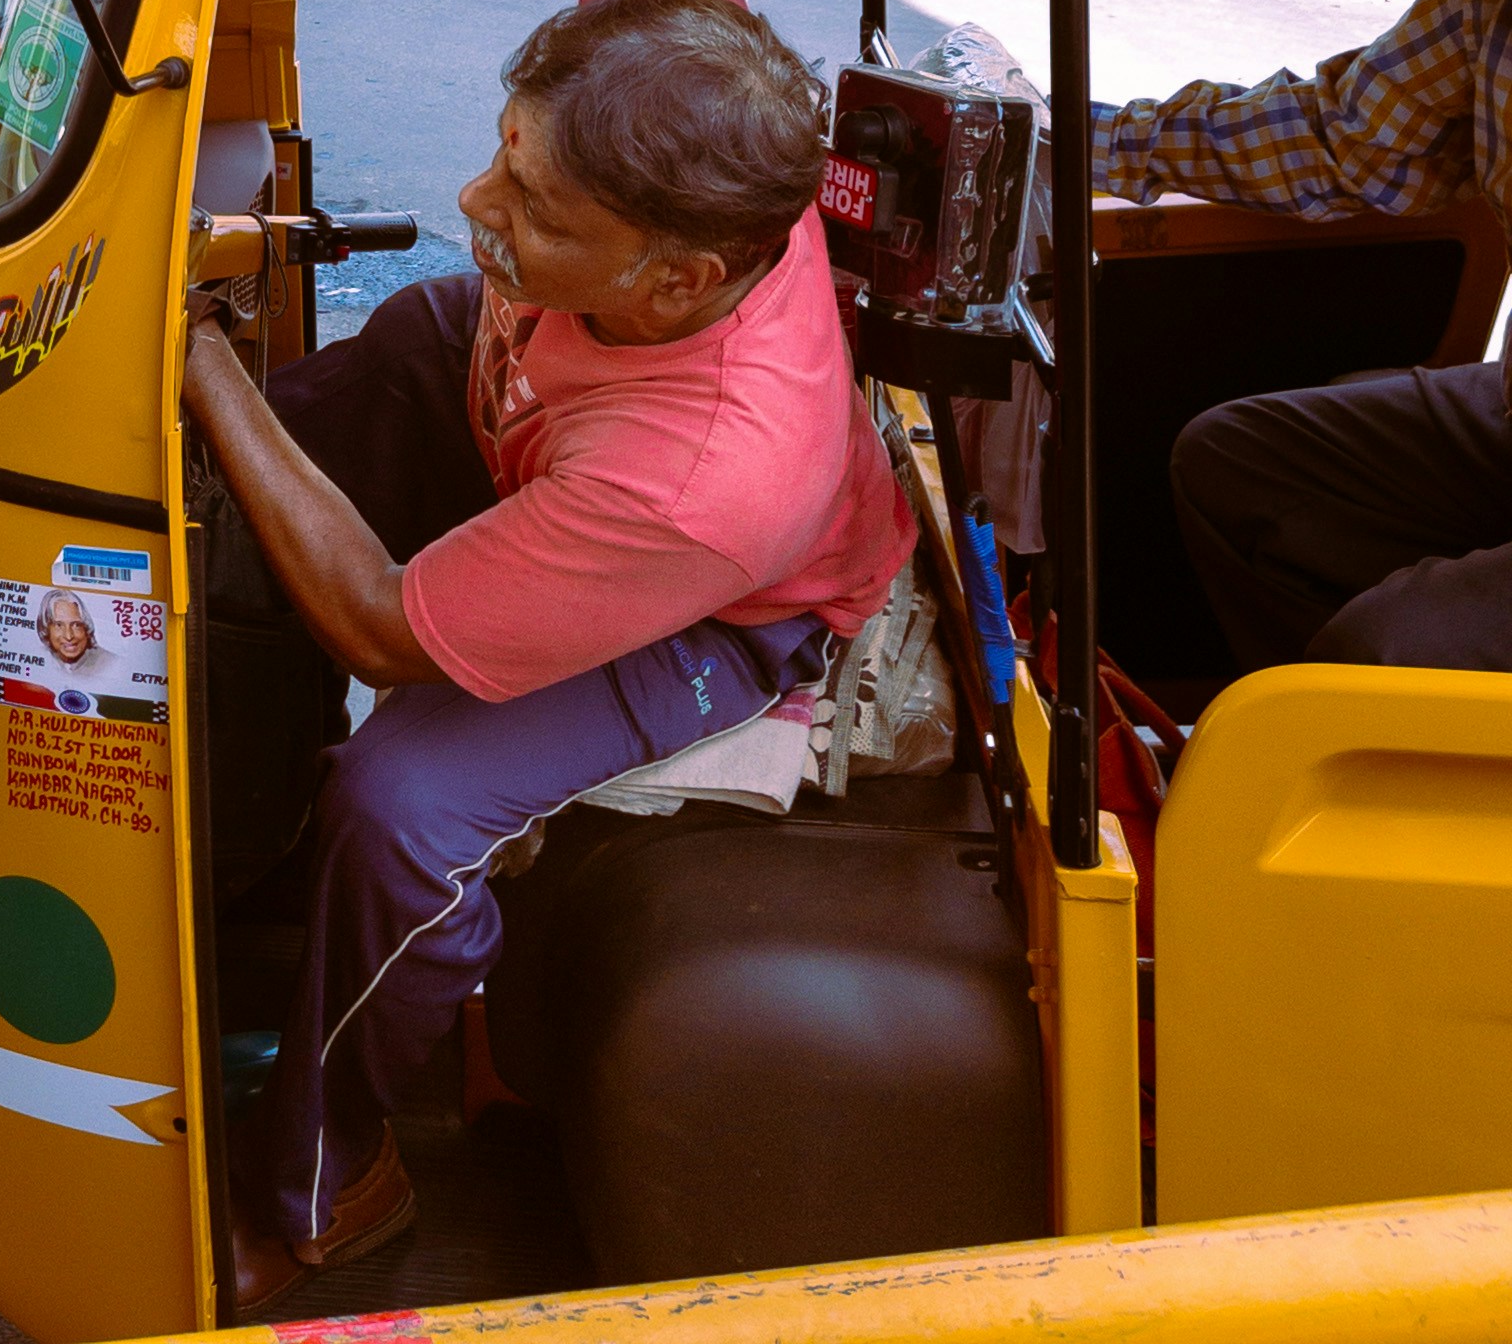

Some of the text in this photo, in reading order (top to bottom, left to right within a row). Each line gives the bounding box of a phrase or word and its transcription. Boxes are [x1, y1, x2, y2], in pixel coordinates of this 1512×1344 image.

[820, 182, 865, 221] FOR
[7, 594, 28, 605] K.M.
[112, 600, 163, 617] 25.00
[4, 617, 35, 630] EXPIRE
[116, 613, 162, 630] 12.00
[120, 624, 164, 642] 3.50
[19, 653, 45, 667] FARE
[131, 672, 170, 686] EXTRA
[691, 676, 713, 716] PLUS
[7, 767, 71, 794] KAMBAR
